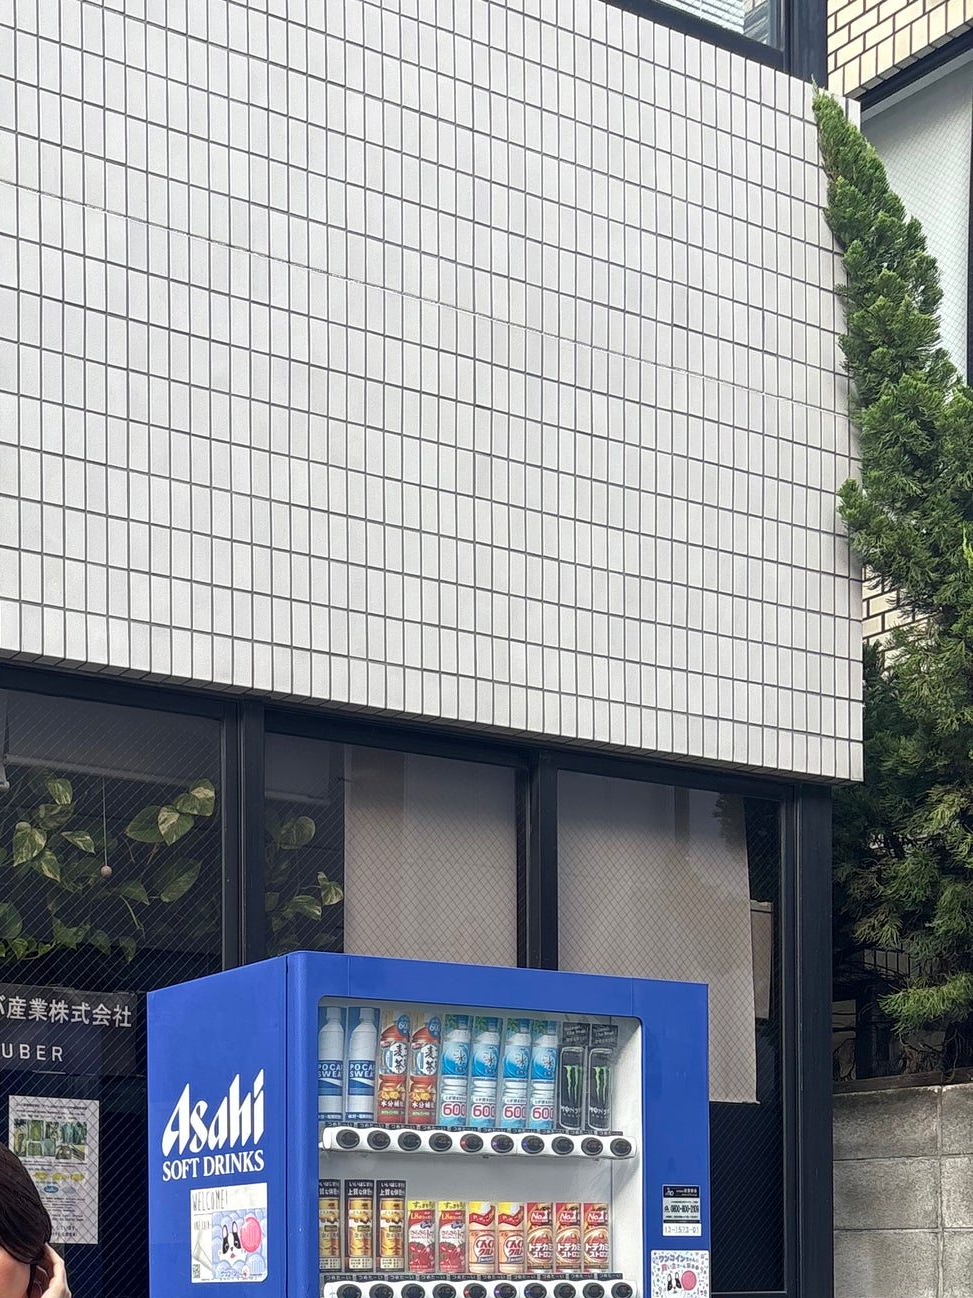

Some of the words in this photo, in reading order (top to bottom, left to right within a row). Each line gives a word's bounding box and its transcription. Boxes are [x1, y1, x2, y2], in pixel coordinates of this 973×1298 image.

[1, 1043, 63, 1061] UBER
[394, 1044, 405, 1073] 麦茶
[425, 1046, 436, 1075] 麦茶
[162, 1068, 264, 1157] Asahi
[162, 1158, 200, 1181] SOFT
[203, 1149, 265, 1177] DRINKS
